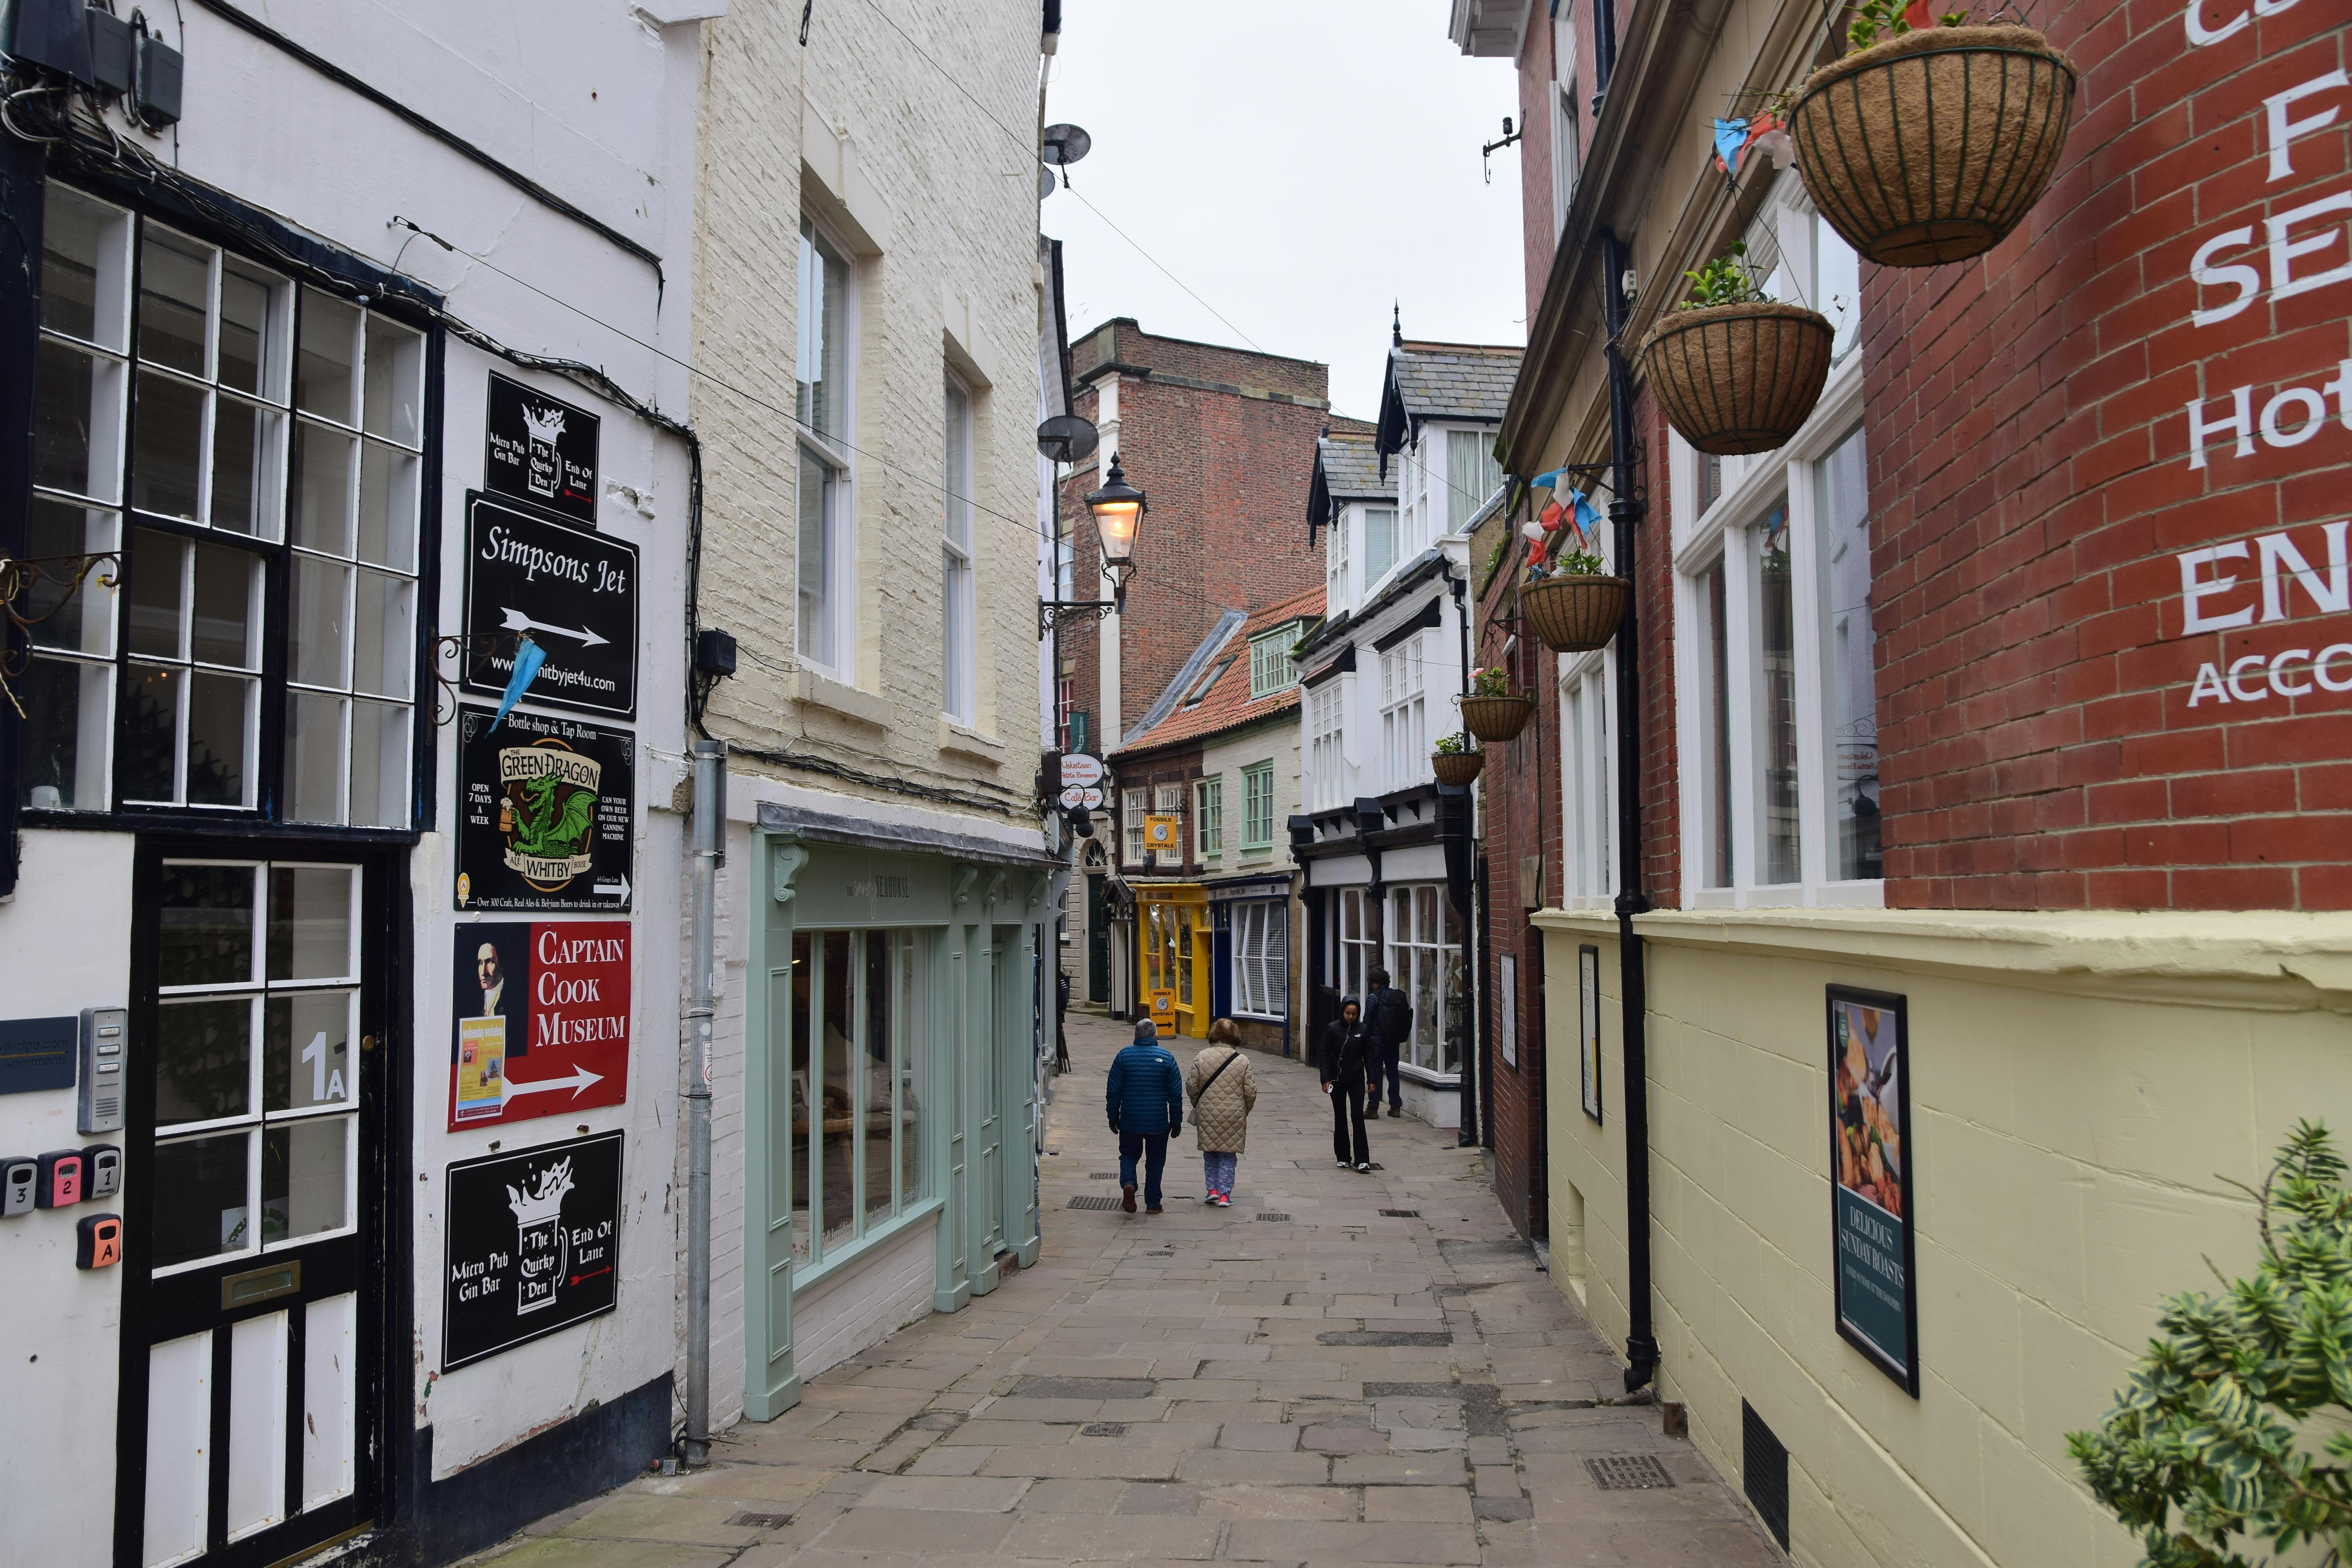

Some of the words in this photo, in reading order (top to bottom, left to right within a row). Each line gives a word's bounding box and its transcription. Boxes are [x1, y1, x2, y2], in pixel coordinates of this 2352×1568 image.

[490, 432, 509, 450] Micro
[513, 441, 524, 455] Pub
[536, 444, 548, 458] The
[494, 448, 506, 462] Gin
[508, 452, 520, 466] Bar
[530, 457, 553, 475] Quirky
[565, 461, 580, 475] End
[583, 468, 592, 479] Of
[535, 474, 548, 486] Den
[570, 475, 587, 490] Lane
[482, 526, 589, 583] Simpsons
[593, 561, 626, 593] Jet
[508, 714, 530, 730] Bottle
[532, 719, 549, 735] shop
[551, 720, 559, 734] &
[561, 722, 575, 739] Tap
[577, 725, 596, 740] Room
[502, 754, 544, 777] GREEN
[544, 753, 600, 788] DRAGON
[472, 783, 489, 793] OPEN
[1065, 792, 1082, 802] Café
[1084, 792, 1098, 801] Bar
[469, 793, 473, 802] 7
[475, 795, 492, 804] DAYS
[470, 815, 489, 825] WEEK
[510, 856, 521, 866] ALE
[526, 860, 571, 878] WHITBY
[876, 875, 909, 898] SEAHORSE
[477, 897, 489, 907] Over
[491, 898, 499, 907] 300
[500, 897, 513, 908] Craft,
[514, 898, 524, 907] Real
[525, 898, 534, 907] Ales
[535, 898, 540, 907] &
[541, 898, 559, 909] Belgium
[561, 899, 573, 907] Beers
[579, 899, 591, 907] drink
[603, 900, 620, 909] takeaway
[539, 931, 625, 965] CAPTAIN
[537, 971, 601, 1005] COOK
[536, 1012, 625, 1047] MUSEUM
[4, 1056, 66, 1069] Apartments
[63, 1180, 71, 1194] 2
[105, 1171, 111, 1185] 1
[16, 1187, 27, 1203] 3
[572, 1227, 593, 1246] End
[597, 1221, 612, 1238] Of
[1850, 1206, 1893, 1251] DELICIOUS
[530, 1232, 548, 1250] The
[102, 1244, 113, 1261] A
[579, 1246, 603, 1264] Lane
[1842, 1228, 1871, 1265] SUNDAY
[1873, 1248, 1904, 1289] ROASTS
[452, 1261, 484, 1282] Micro
[489, 1251, 508, 1270] Pub
[521, 1254, 554, 1278] Quirky
[459, 1281, 477, 1302] Gin
[482, 1276, 500, 1295] Bar
[528, 1281, 547, 1298] Den
